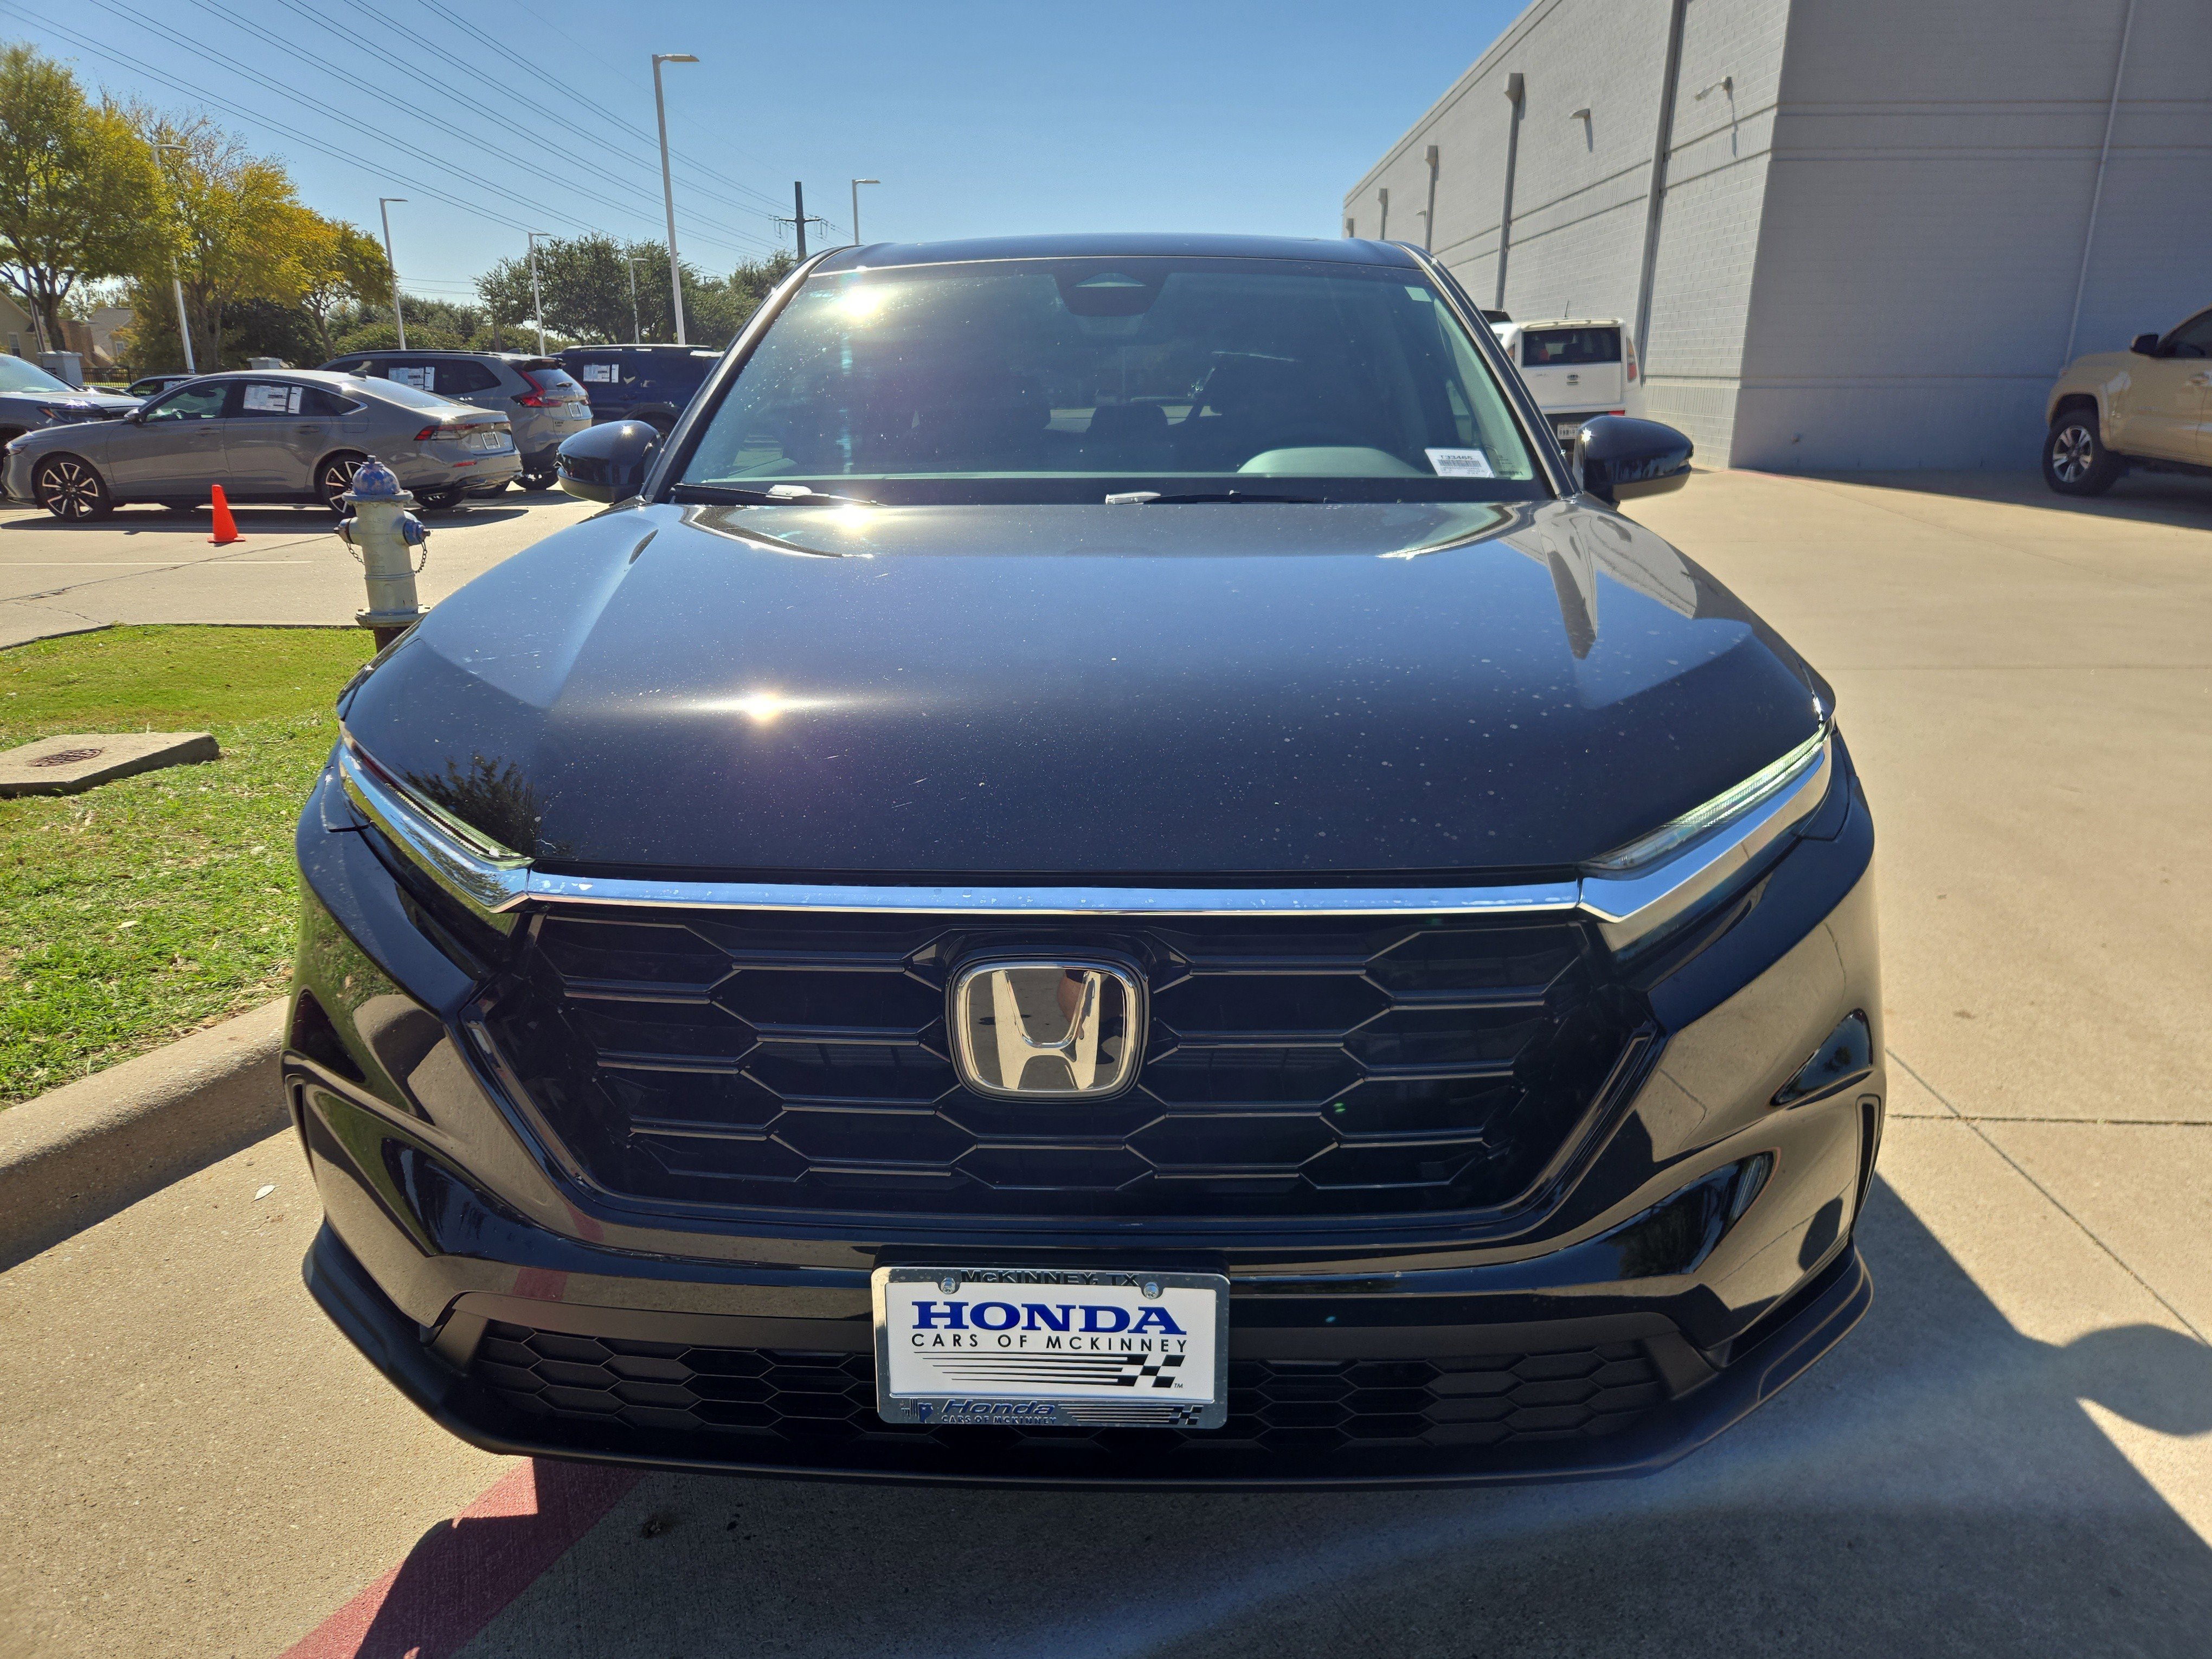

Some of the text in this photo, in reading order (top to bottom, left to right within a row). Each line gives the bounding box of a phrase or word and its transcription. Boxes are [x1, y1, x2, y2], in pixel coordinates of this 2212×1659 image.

[1105, 1272, 1140, 1287] TX
[911, 1301, 1187, 1335] HONDA
[911, 1333, 1187, 1353] CARS OF MCKINNEY
[941, 1399, 1056, 1415] Honda
[941, 1414, 1057, 1424] CARS OF MCKINNEY
